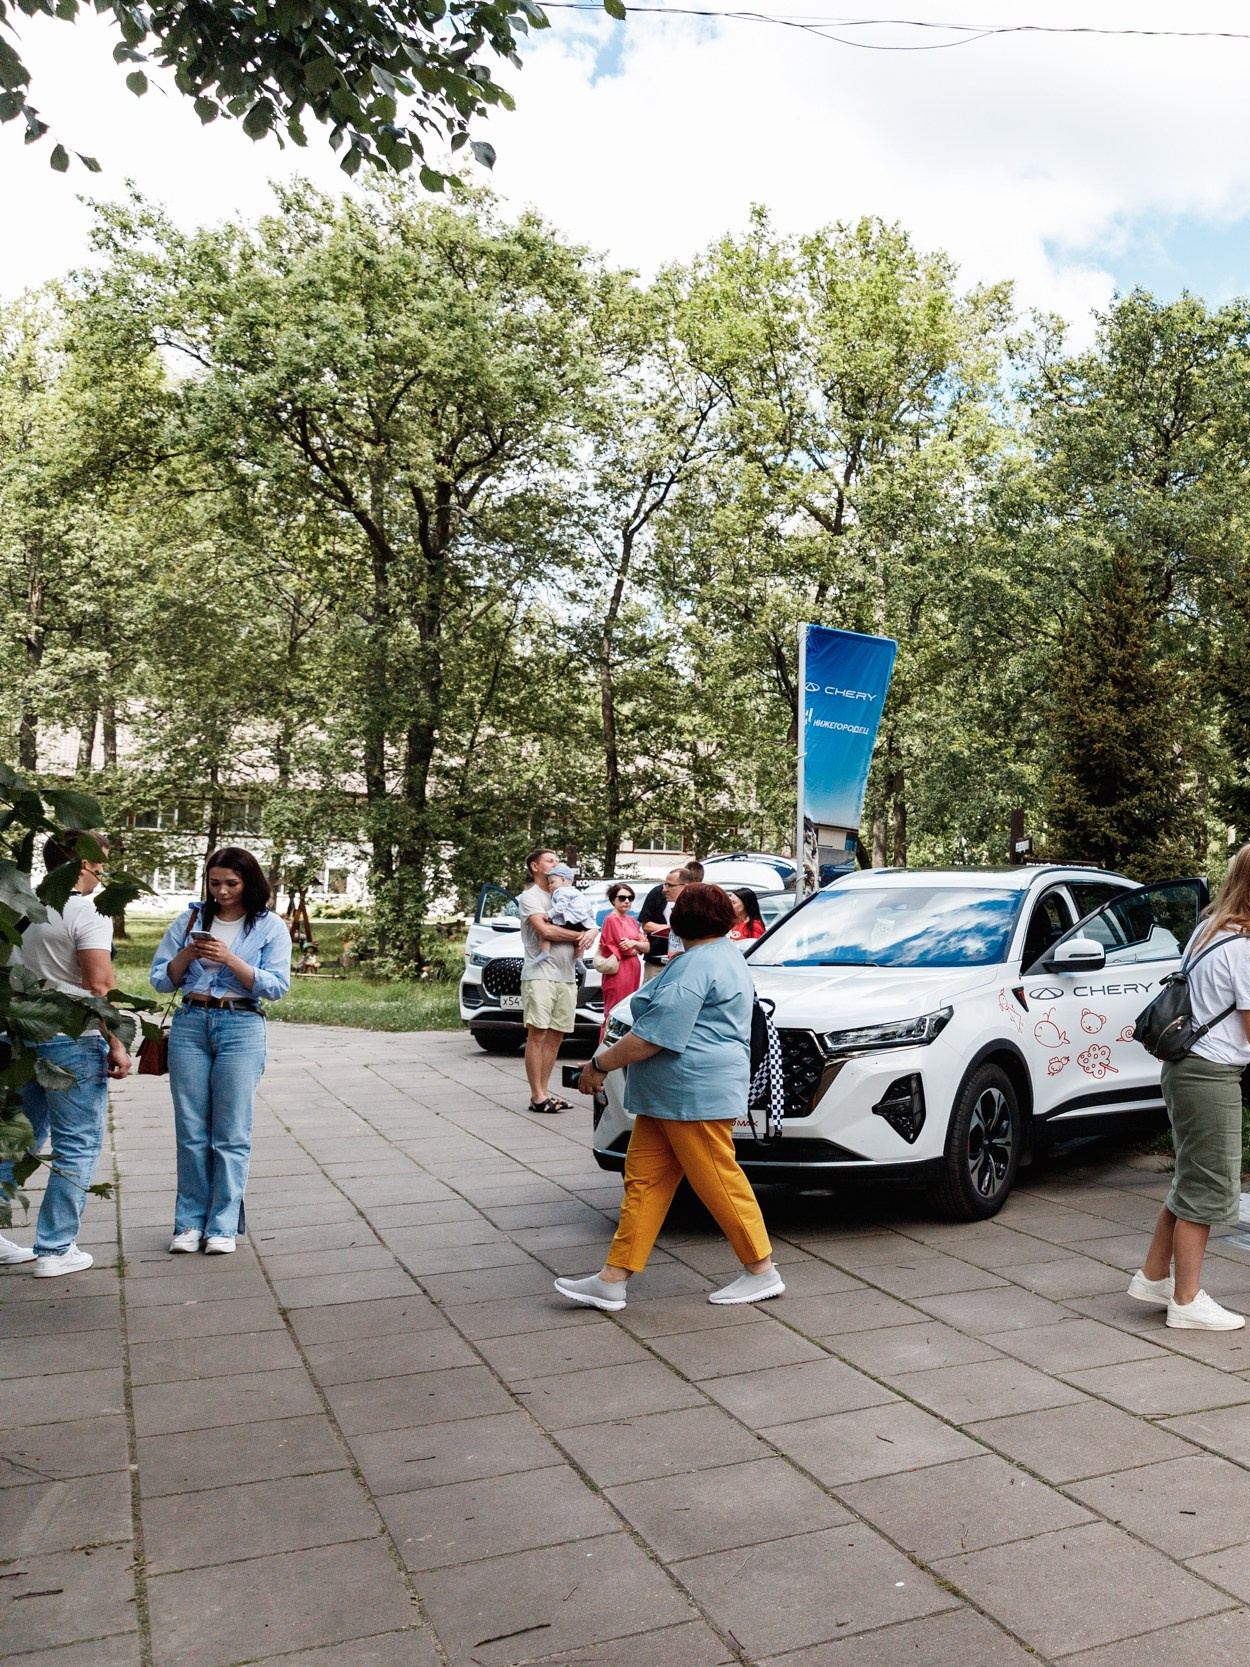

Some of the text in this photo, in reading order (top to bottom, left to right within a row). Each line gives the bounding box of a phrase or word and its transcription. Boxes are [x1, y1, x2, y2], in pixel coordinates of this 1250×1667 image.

[824, 686, 877, 702] CHERY
[812, 718, 870, 735] НИЖЕГОРОДЕЦ
[1072, 982, 1154, 997] CHERY
